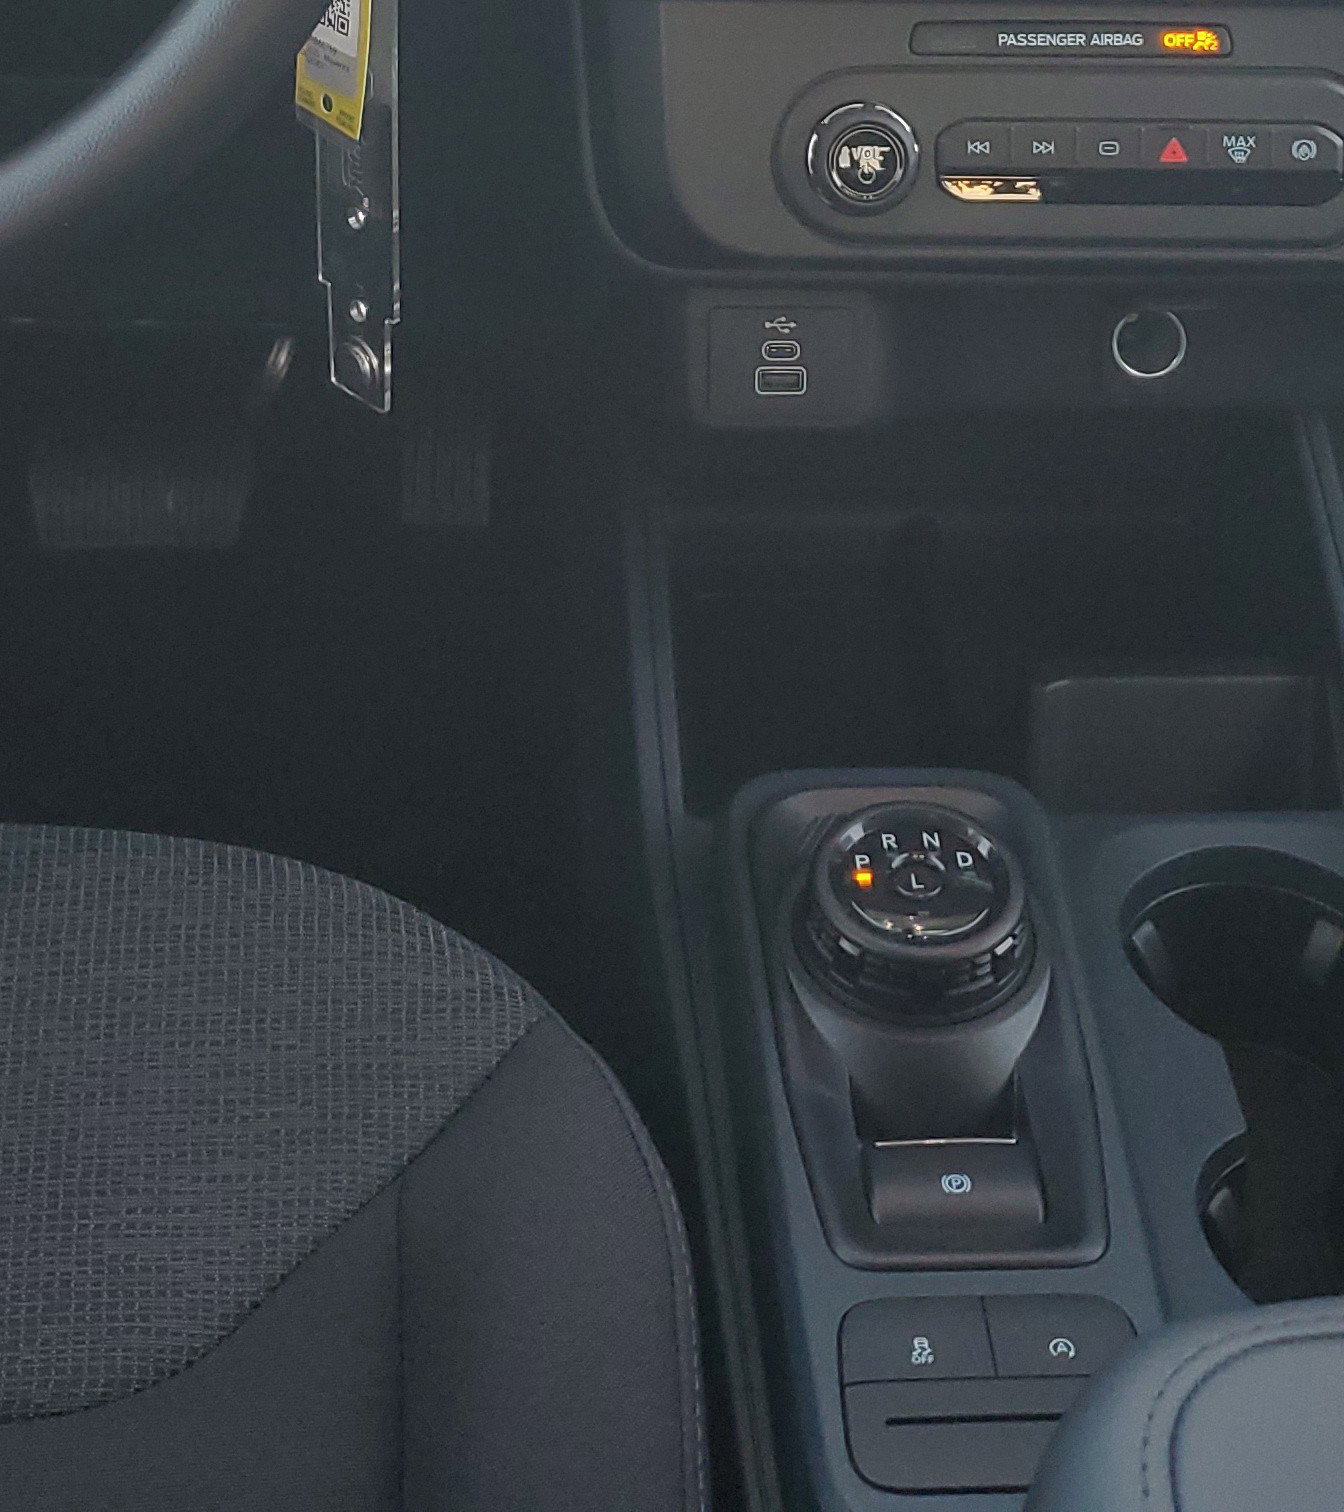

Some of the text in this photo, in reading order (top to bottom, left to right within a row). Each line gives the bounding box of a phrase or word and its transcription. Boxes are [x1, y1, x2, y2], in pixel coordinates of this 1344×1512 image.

[998, 32, 1145, 47] PASSENGER AIRBAG
[1163, 33, 1195, 47] OFF
[1222, 135, 1256, 148] MAX
[855, 830, 973, 869] P R N D
[910, 872, 925, 889] L
[911, 1354, 935, 1365] OFF
